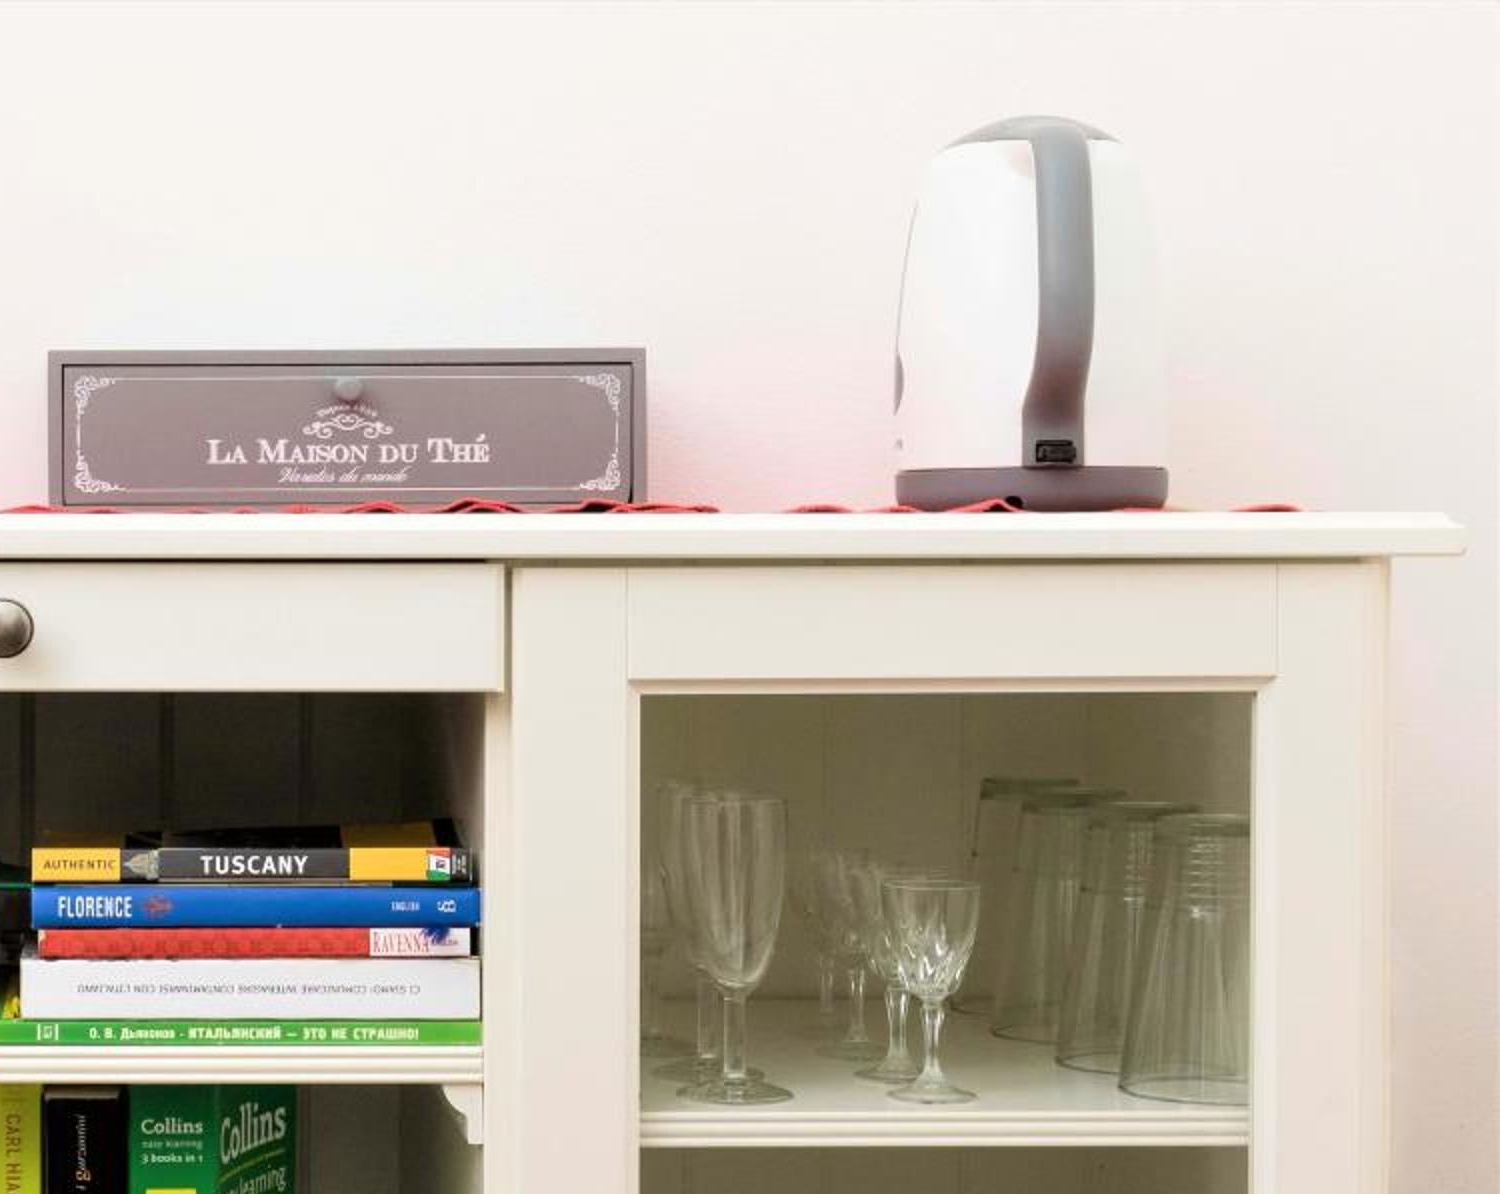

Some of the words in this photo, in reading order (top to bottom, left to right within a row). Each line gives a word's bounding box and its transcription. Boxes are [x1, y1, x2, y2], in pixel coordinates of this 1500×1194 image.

[43, 859, 116, 871] AUTHENTIC
[200, 855, 309, 875] TUSCANY
[58, 896, 133, 918] FLORENCE
[372, 931, 429, 953] RAVENNA
[188, 1026, 281, 1040] ИТАЛЬЯНСКИЙ
[303, 1027, 327, 1040] ЭТО
[331, 1027, 348, 1040] НЕ
[353, 1027, 420, 1040] СТРАШНО!
[6, 1114, 21, 1156] CARL
[141, 1118, 203, 1135] Collins
[220, 1102, 286, 1165] Collins
[141, 1154, 149, 1165] 3
[151, 1153, 182, 1163] books
[186, 1154, 196, 1163] in
